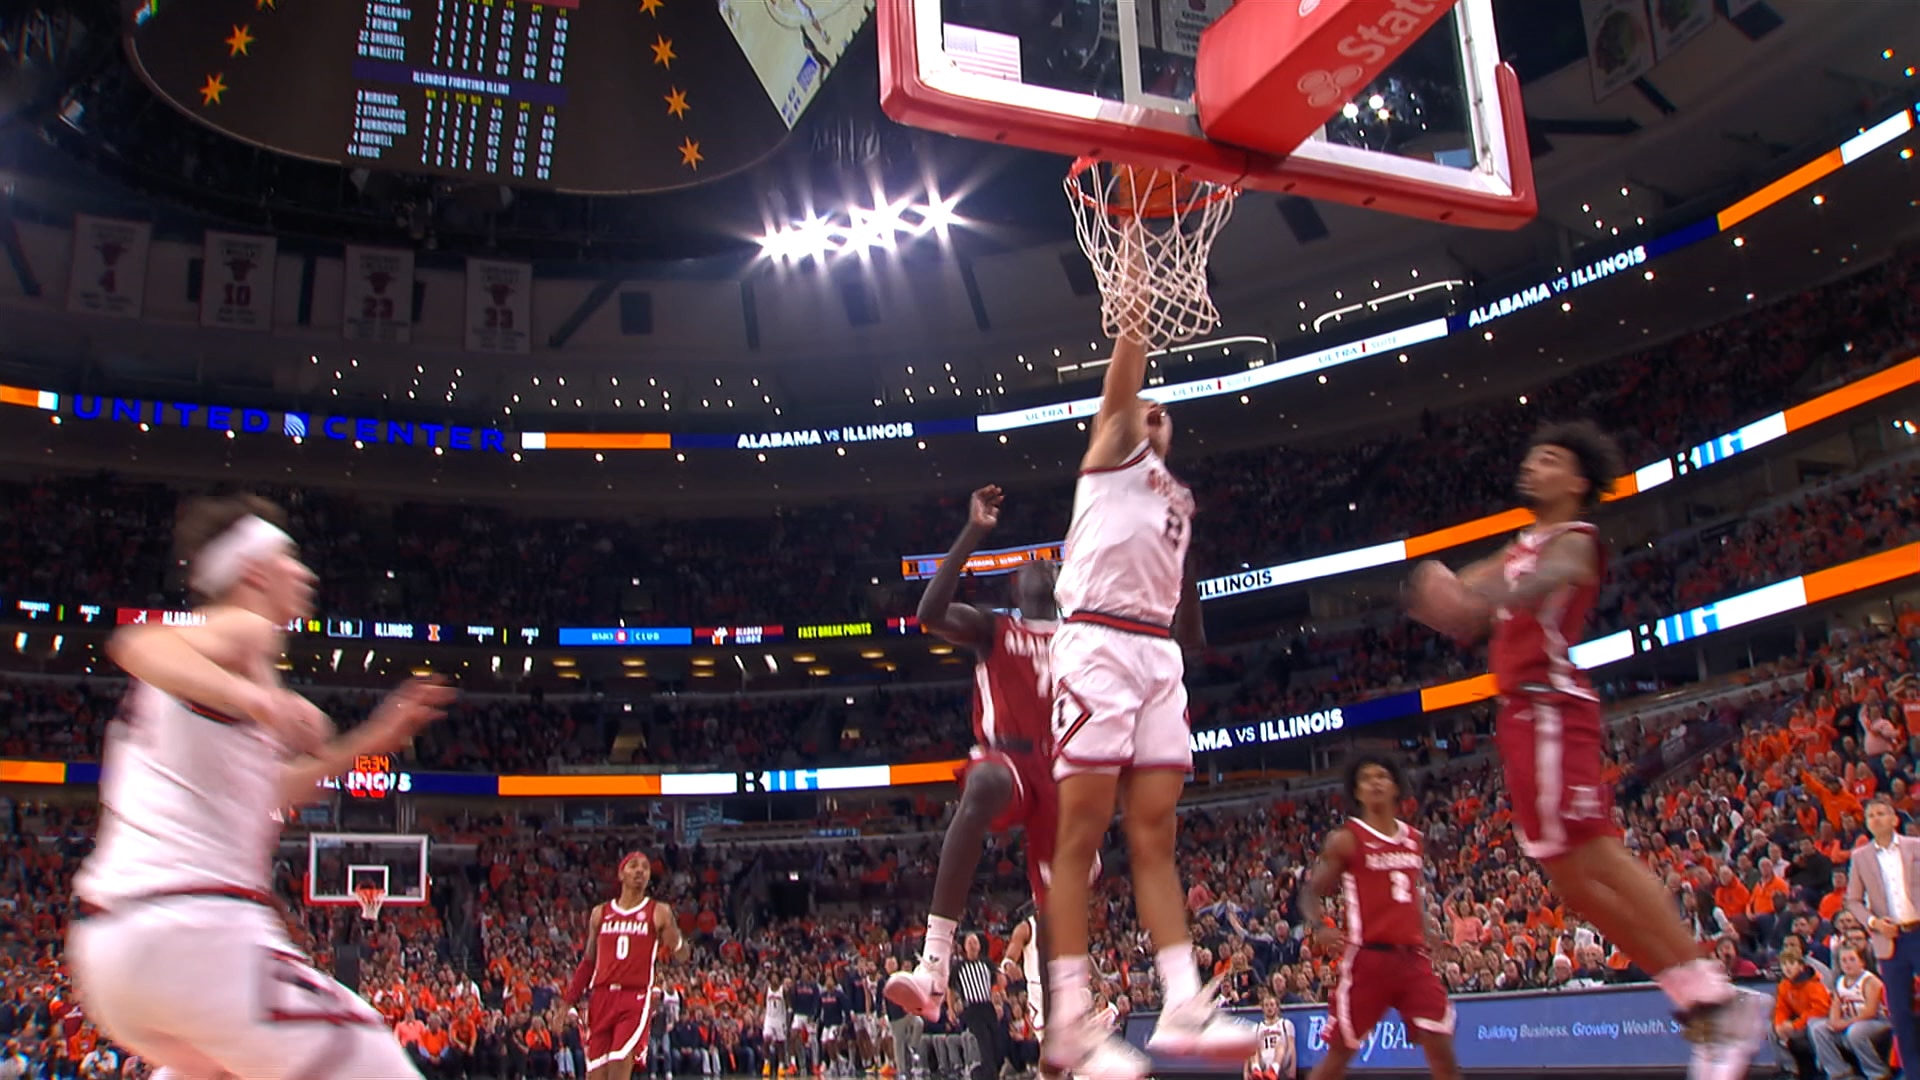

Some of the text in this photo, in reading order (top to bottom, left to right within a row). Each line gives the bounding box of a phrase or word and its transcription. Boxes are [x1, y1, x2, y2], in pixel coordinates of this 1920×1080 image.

[374, 4, 411, 19] HOLLOWAY
[1337, 0, 1441, 64] Stat
[412, 71, 510, 95] ILLINOIS FIGHTING ILLINI
[363, 105, 405, 120] STOJAKOVIC
[1467, 245, 1647, 328] ALABAMA VS ILLINOIS
[1172, 383, 1213, 398] ULTRA
[72, 394, 506, 453] UNITED CENTER
[1025, 407, 1064, 422] ULTRA
[737, 422, 914, 449] ALABAMA VS ILLINOIS
[1198, 570, 1273, 598] ILLINOIS
[374, 622, 413, 638] ILLINOIS
[798, 622, 872, 639] FAST BREAK POINTS
[1236, 726, 1256, 745] VS
[1260, 708, 1344, 743] ILLINOIS
[1389, 870, 1413, 904] 2
[600, 920, 649, 936] ALABAMA
[616, 935, 630, 961] 0
[1477, 1024, 1518, 1042] Building
[1519, 1022, 1570, 1038] Business.
[1571, 1020, 1620, 1039] Growing
[1622, 1018, 1667, 1035] Wealth.
